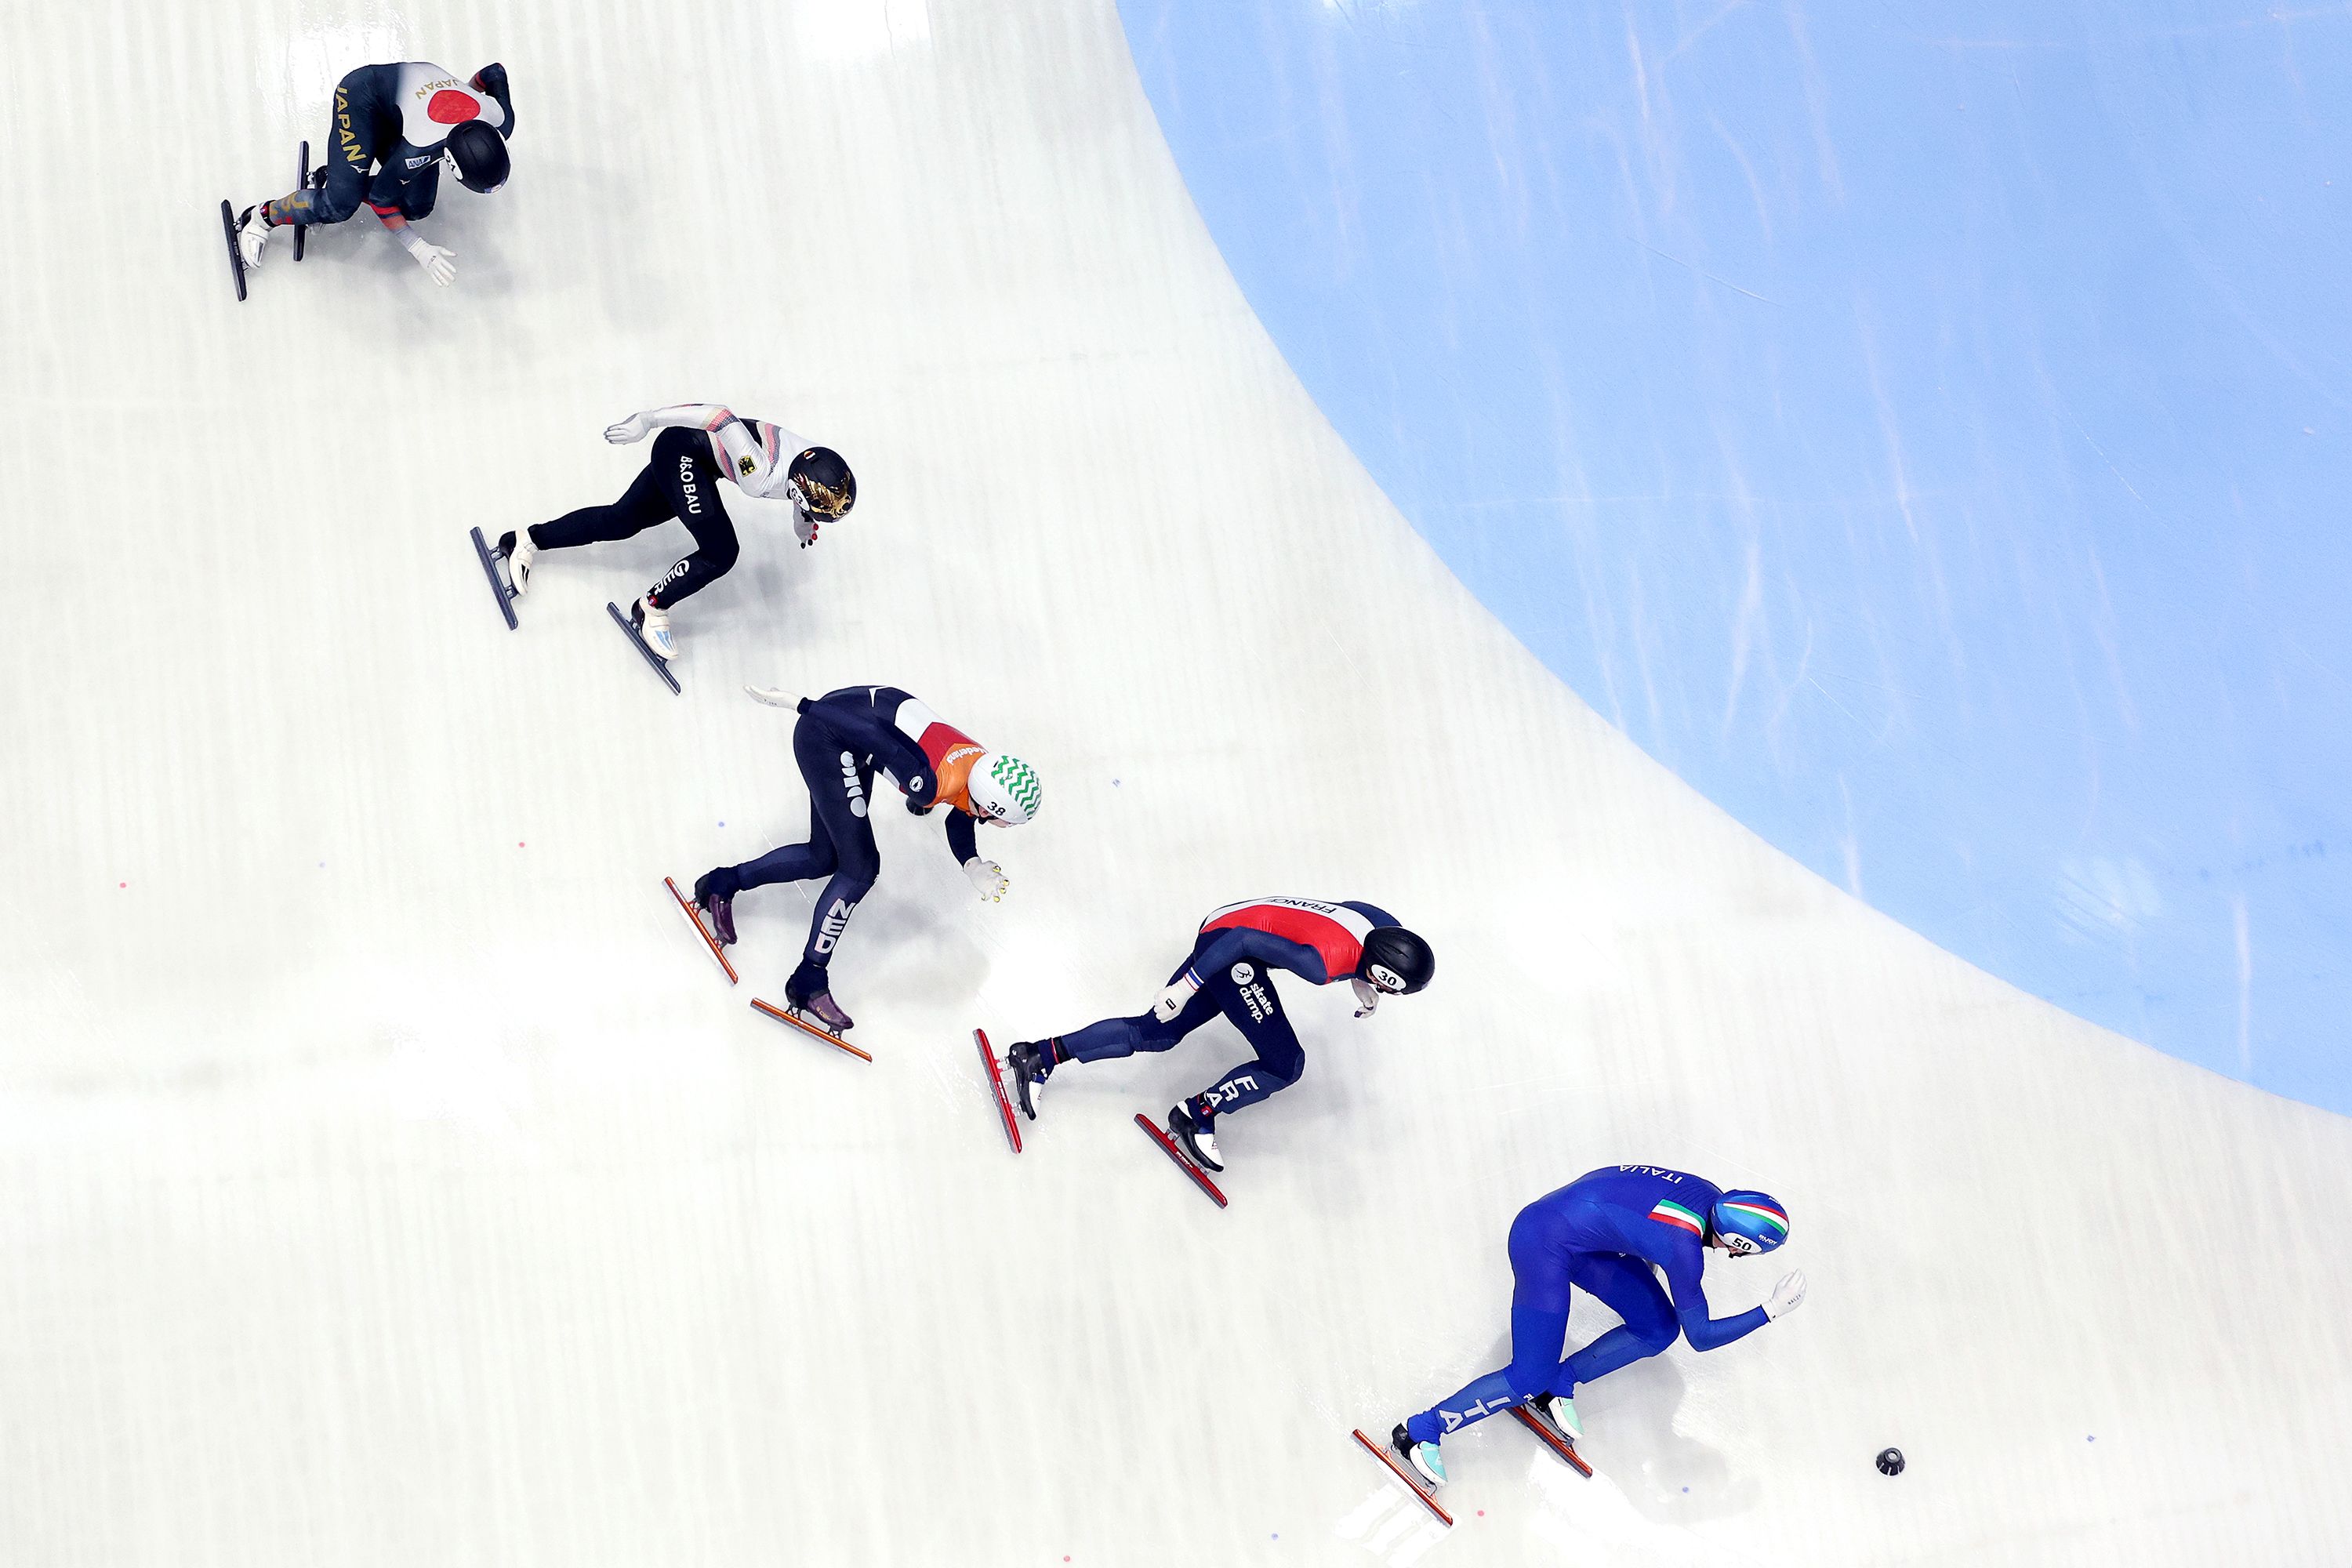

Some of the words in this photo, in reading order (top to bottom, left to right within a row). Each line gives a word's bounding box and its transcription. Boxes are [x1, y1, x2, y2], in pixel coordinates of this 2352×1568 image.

[416, 79, 460, 100] JAPAN
[987, 801, 1006, 816] 38
[815, 898, 856, 954] NED
[1378, 971, 1397, 985] 30
[1240, 987, 1263, 1024] dump.
[1250, 983, 1273, 1015] skate
[1207, 1075, 1259, 1108] FRA
[1620, 1165, 1683, 1184] ITALIA
[1732, 1237, 1752, 1250] 50
[1759, 1234, 1777, 1246] RUDY
[1439, 1396, 1511, 1433] ITA
